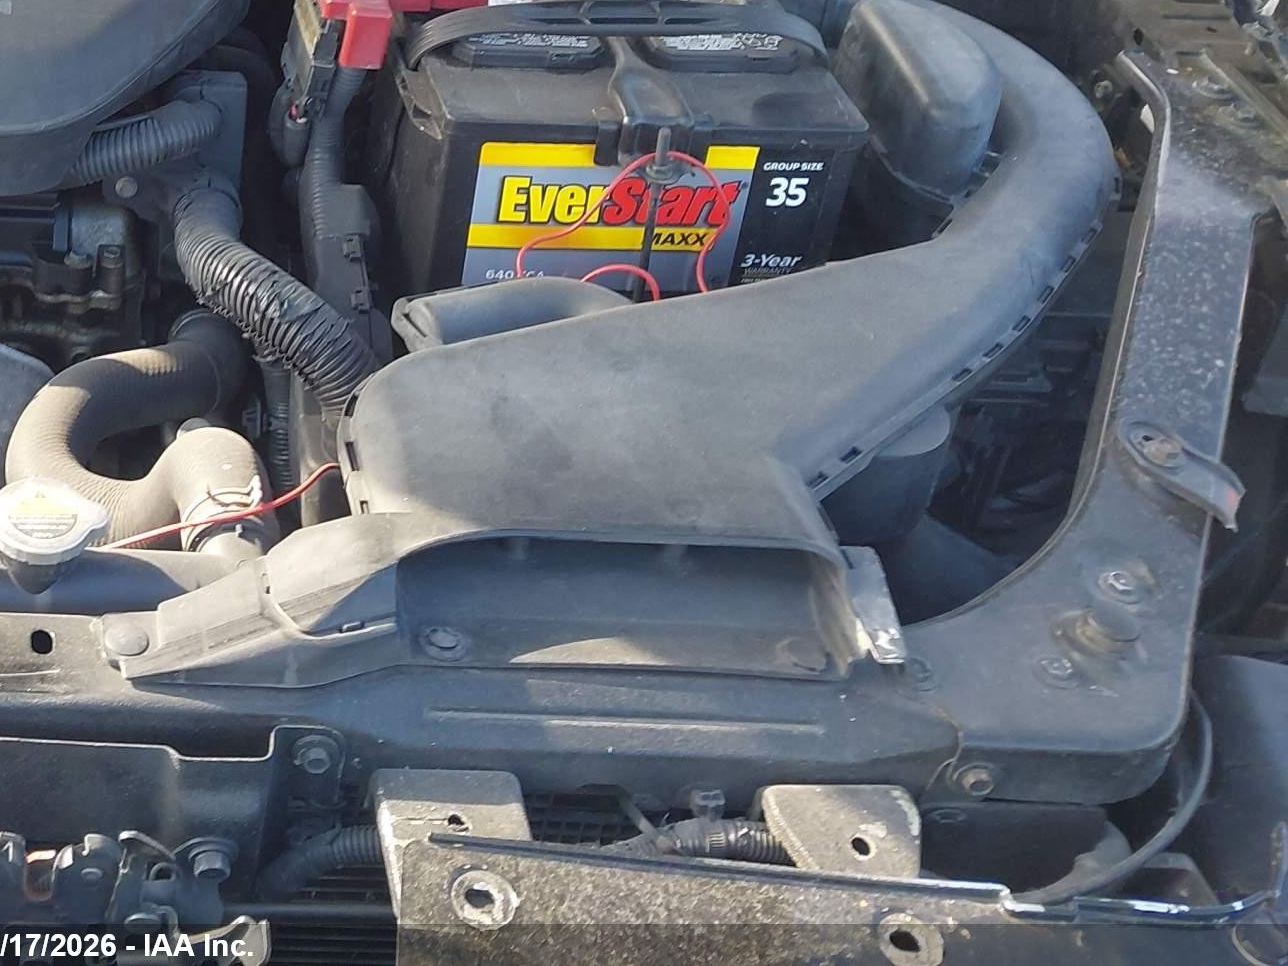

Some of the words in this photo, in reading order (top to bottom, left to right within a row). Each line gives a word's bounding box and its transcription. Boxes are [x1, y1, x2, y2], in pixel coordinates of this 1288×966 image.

[763, 161, 800, 171] GROUP
[800, 161, 825, 172] SIZE
[765, 177, 810, 207] 35
[741, 253, 803, 268] 3-Year
[485, 269, 514, 280] 640
